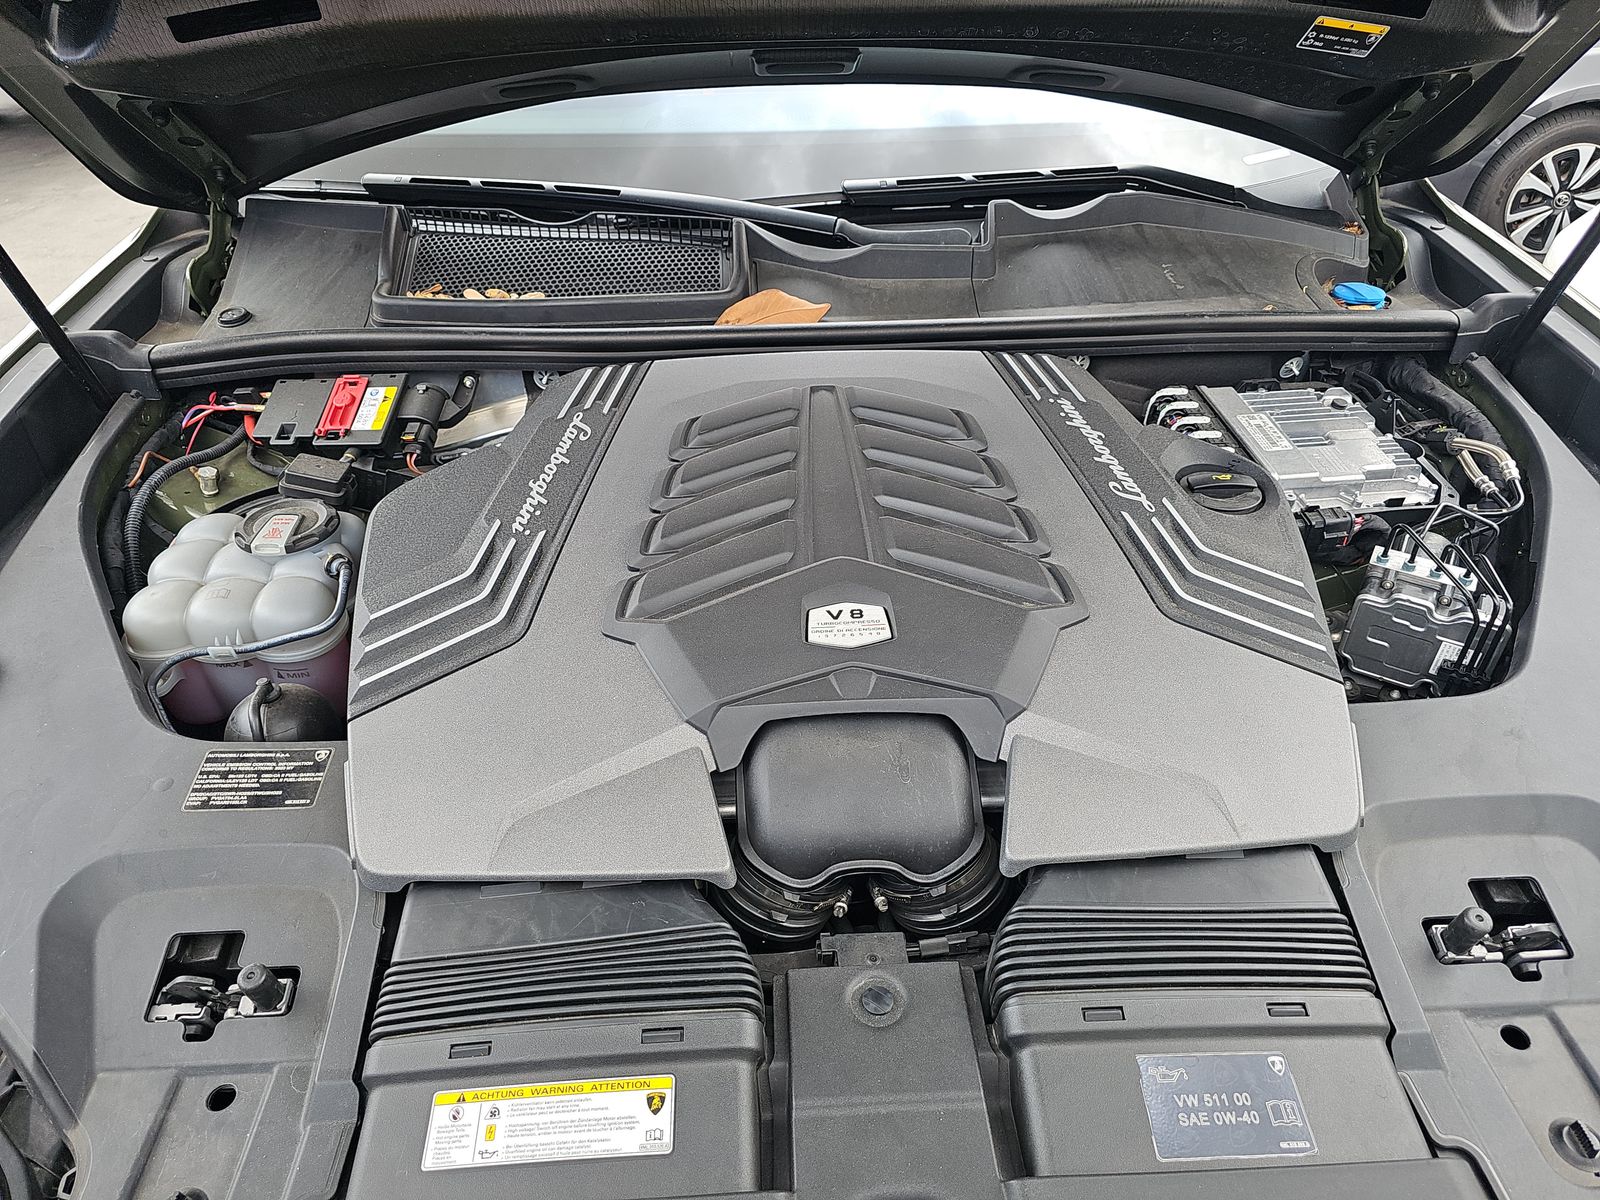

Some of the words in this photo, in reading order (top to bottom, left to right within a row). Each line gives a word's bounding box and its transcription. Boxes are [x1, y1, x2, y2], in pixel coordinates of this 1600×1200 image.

[1048, 398, 1156, 512] Lamborghini
[512, 412, 592, 536] Lamborghini
[472, 1089, 524, 1101] ACHTUNG
[530, 1084, 584, 1096] WARNING
[591, 1080, 651, 1092] ATTENTION
[1174, 1094, 1199, 1108] VW
[1204, 1094, 1229, 1106] 511
[1234, 1093, 1252, 1106] 00
[1178, 1112, 1210, 1126] SAE
[1214, 1111, 1260, 1125] 0W-40
